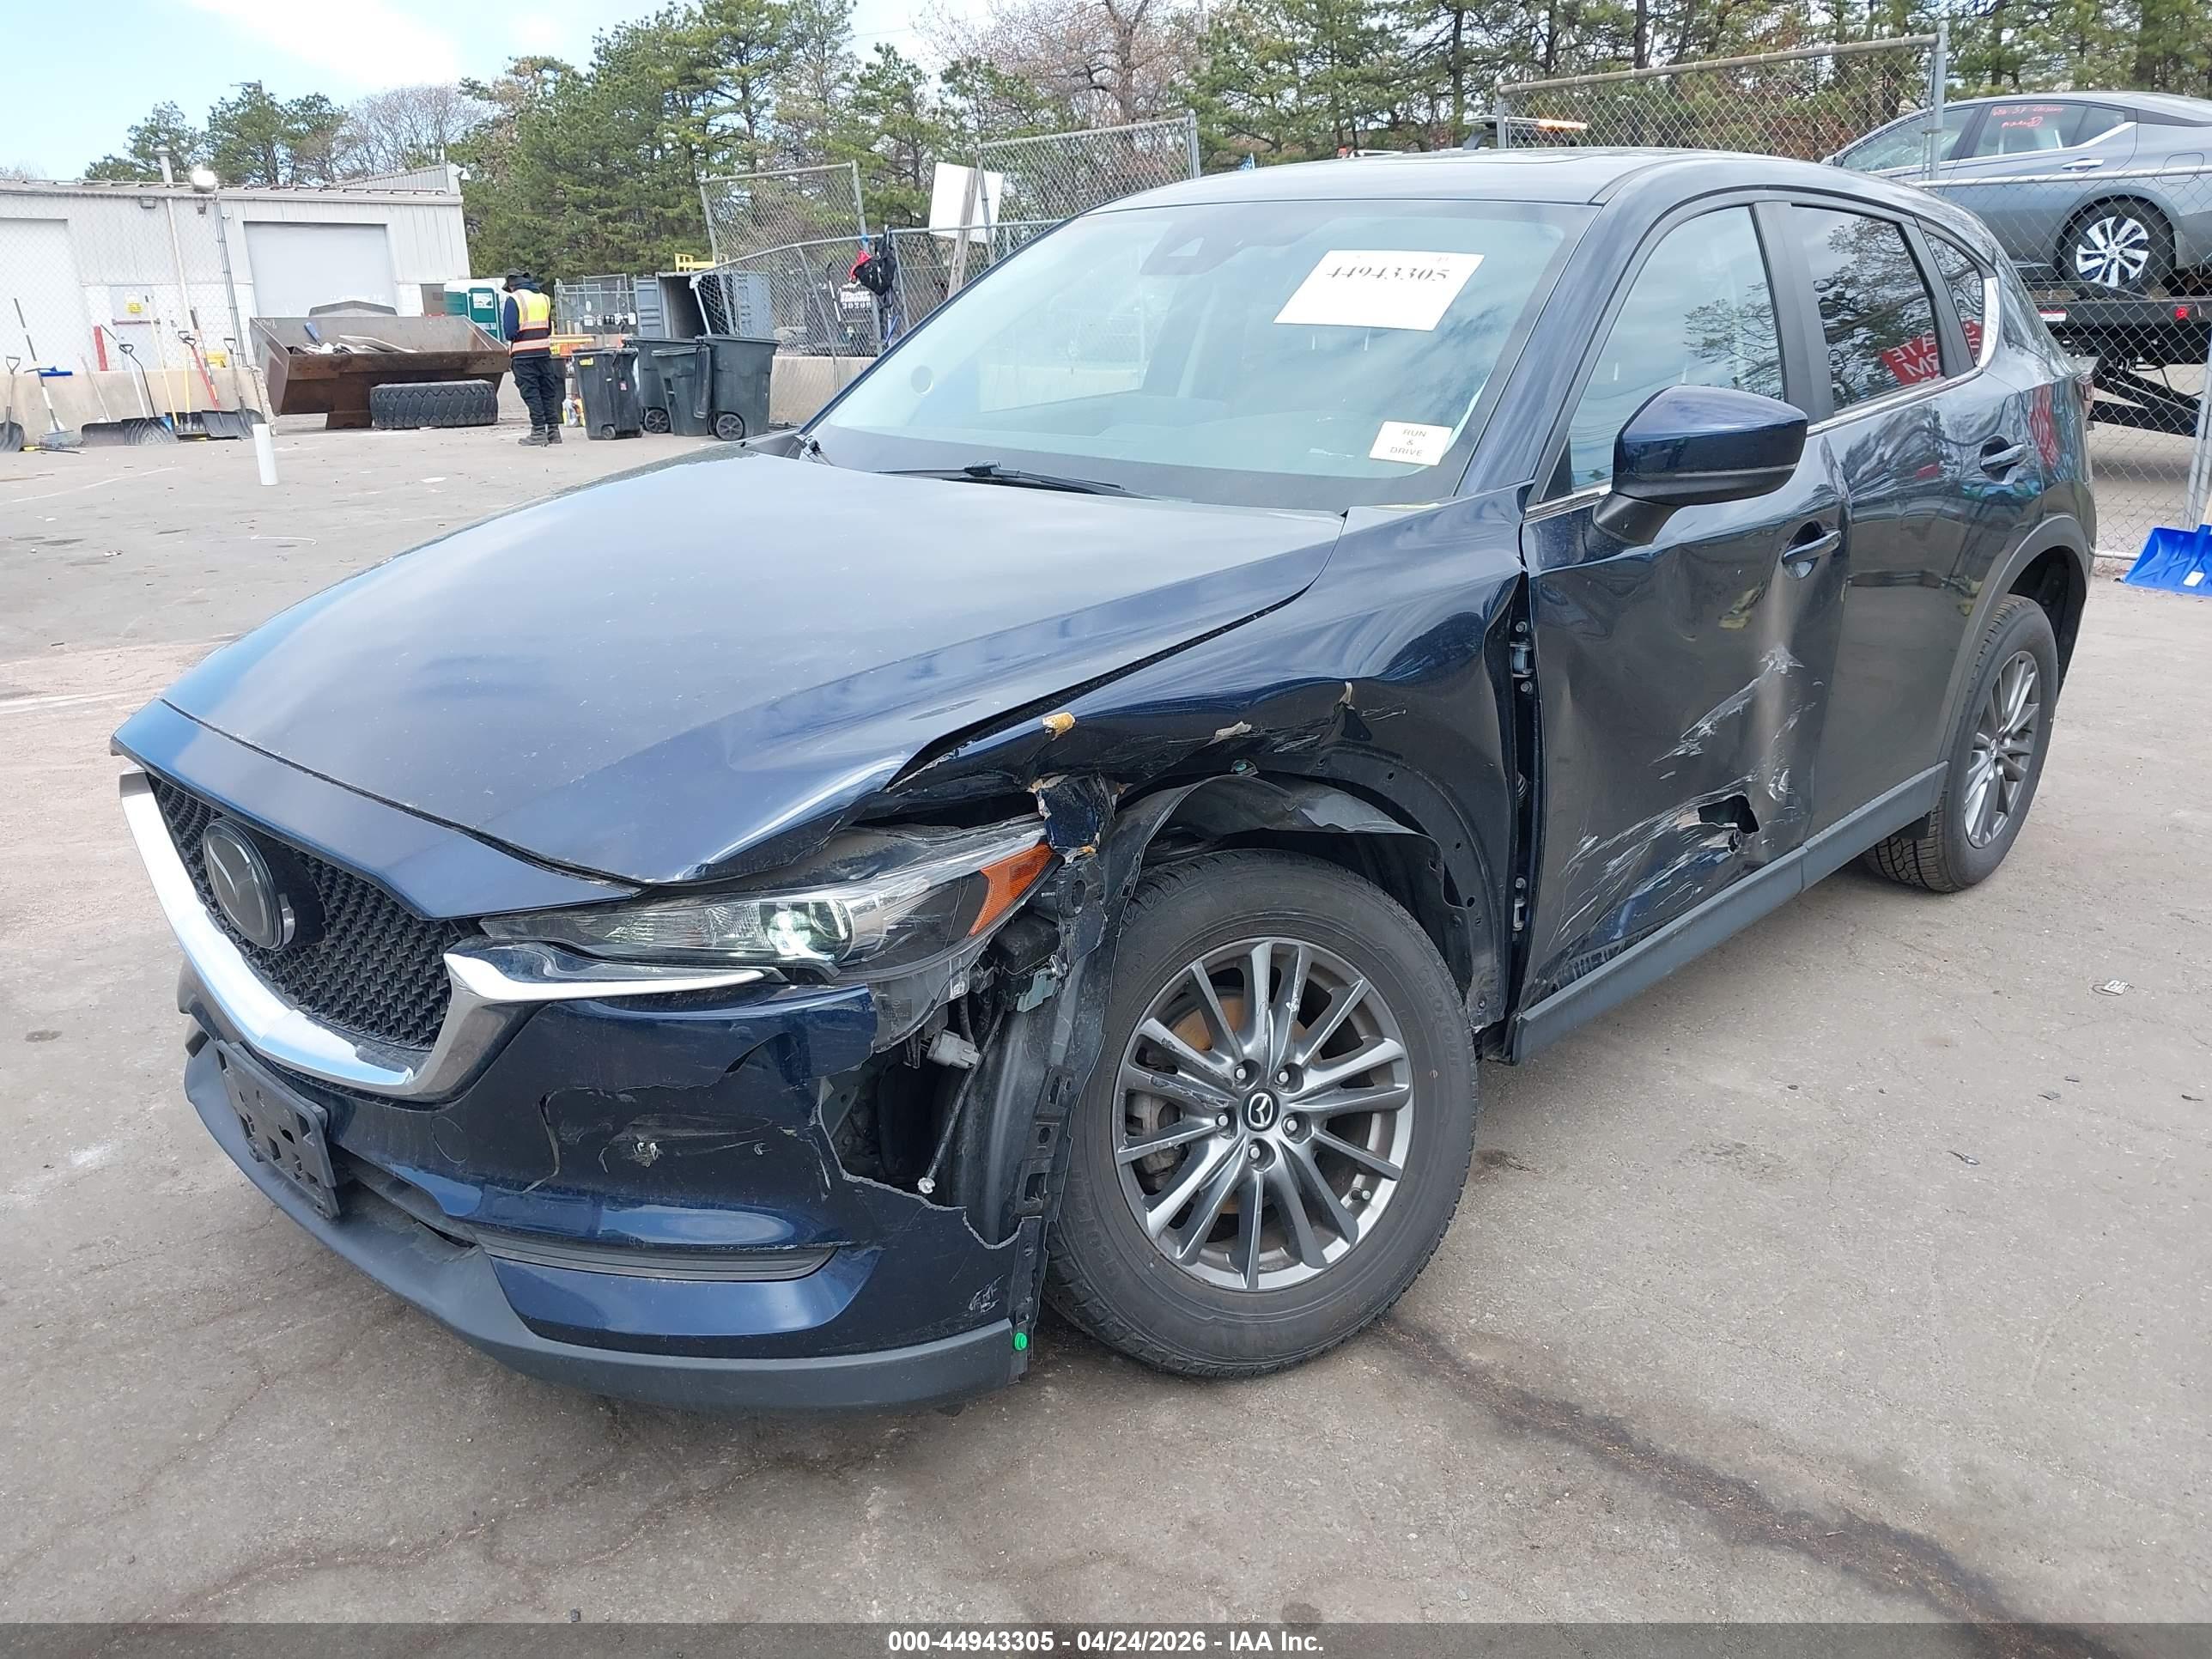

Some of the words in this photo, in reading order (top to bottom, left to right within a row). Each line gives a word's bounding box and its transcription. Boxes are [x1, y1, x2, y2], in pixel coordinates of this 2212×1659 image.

[1325, 266, 1450, 281] 44943305
[1402, 428, 1427, 437] RUN
[1389, 447, 1423, 456] DRIVE
